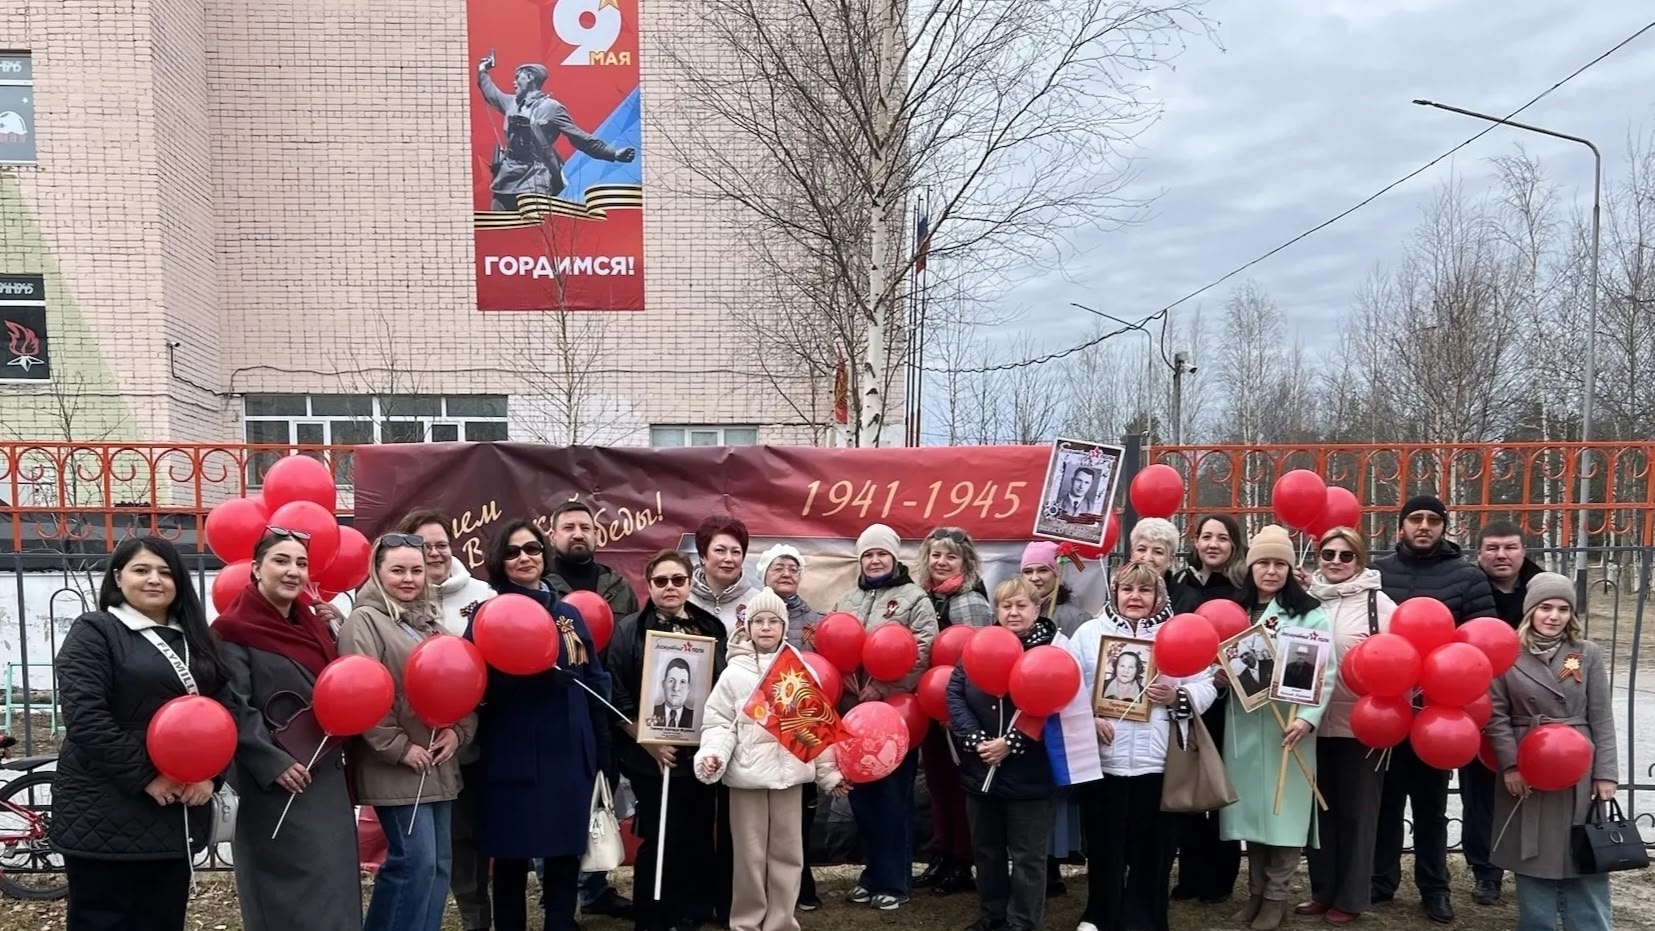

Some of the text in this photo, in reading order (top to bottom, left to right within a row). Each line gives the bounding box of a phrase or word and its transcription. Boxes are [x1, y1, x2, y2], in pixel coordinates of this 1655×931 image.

[552, 0, 632, 66] 9 МАЯ
[484, 255, 635, 280] ГОРДИМСЯ!
[594, 490, 664, 548] беды!
[801, 479, 1028, 519] 1941-1945
